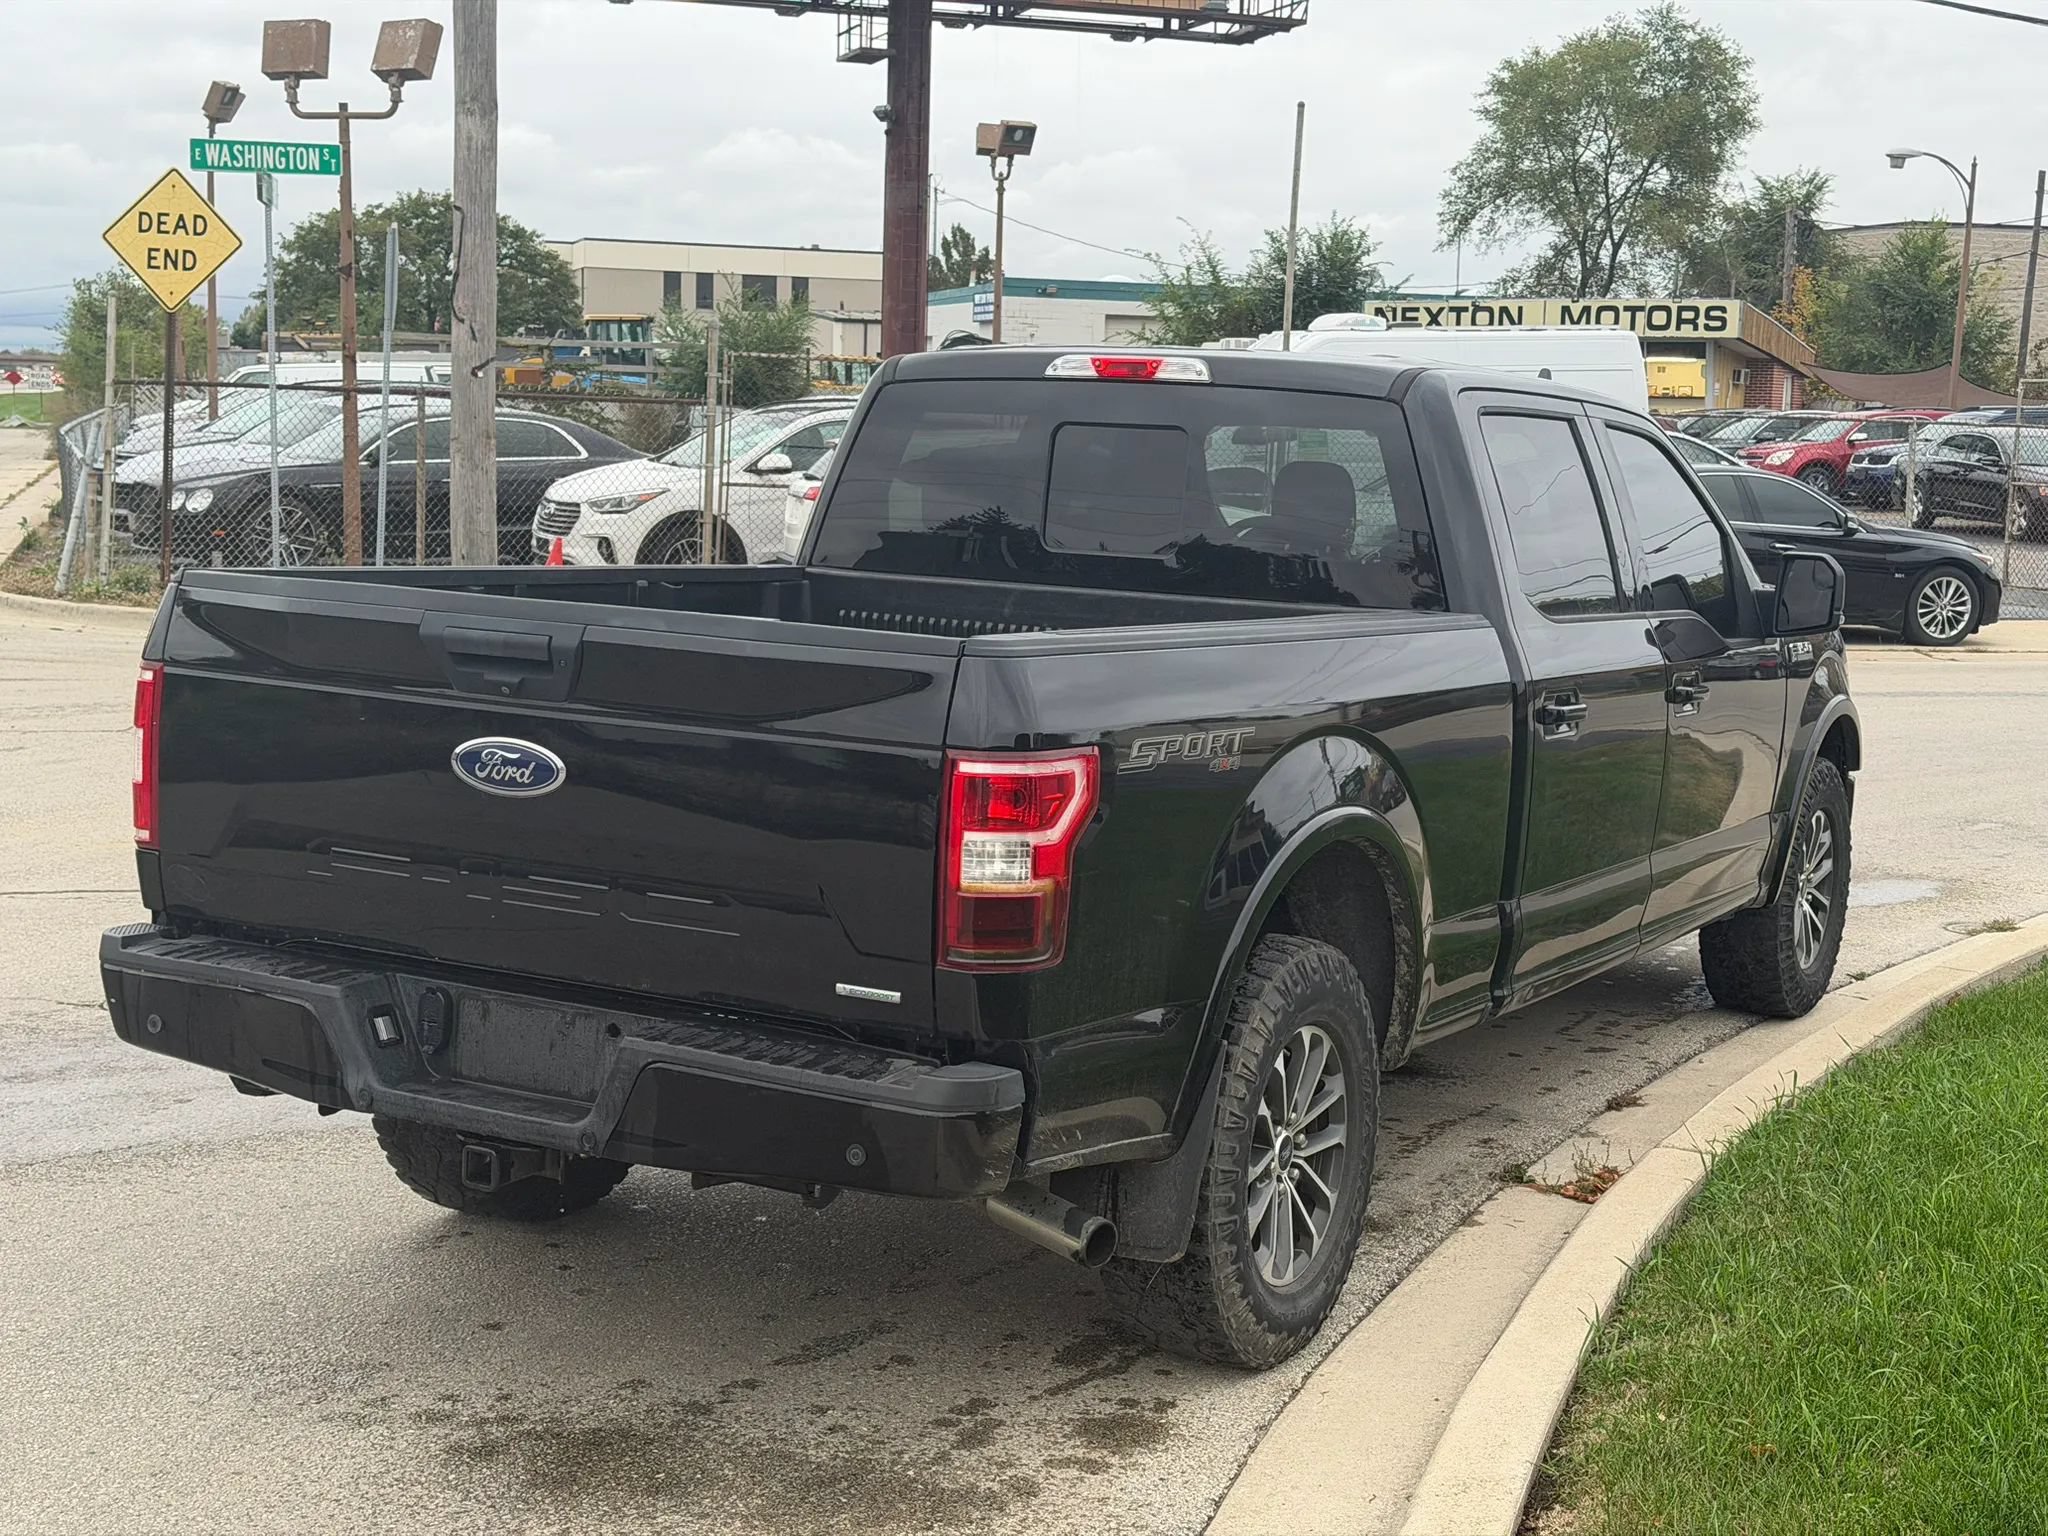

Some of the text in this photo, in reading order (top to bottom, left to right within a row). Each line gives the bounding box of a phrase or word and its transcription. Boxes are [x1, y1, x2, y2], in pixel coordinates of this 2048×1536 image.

[194, 147, 201, 160] E
[204, 143, 320, 171] WASHINGTON
[138, 211, 208, 236] DEAD
[146, 247, 198, 271] END
[1374, 305, 1728, 332] NEXTON MOTORS
[1117, 727, 1256, 774] SPORT
[474, 748, 537, 784] Ford
